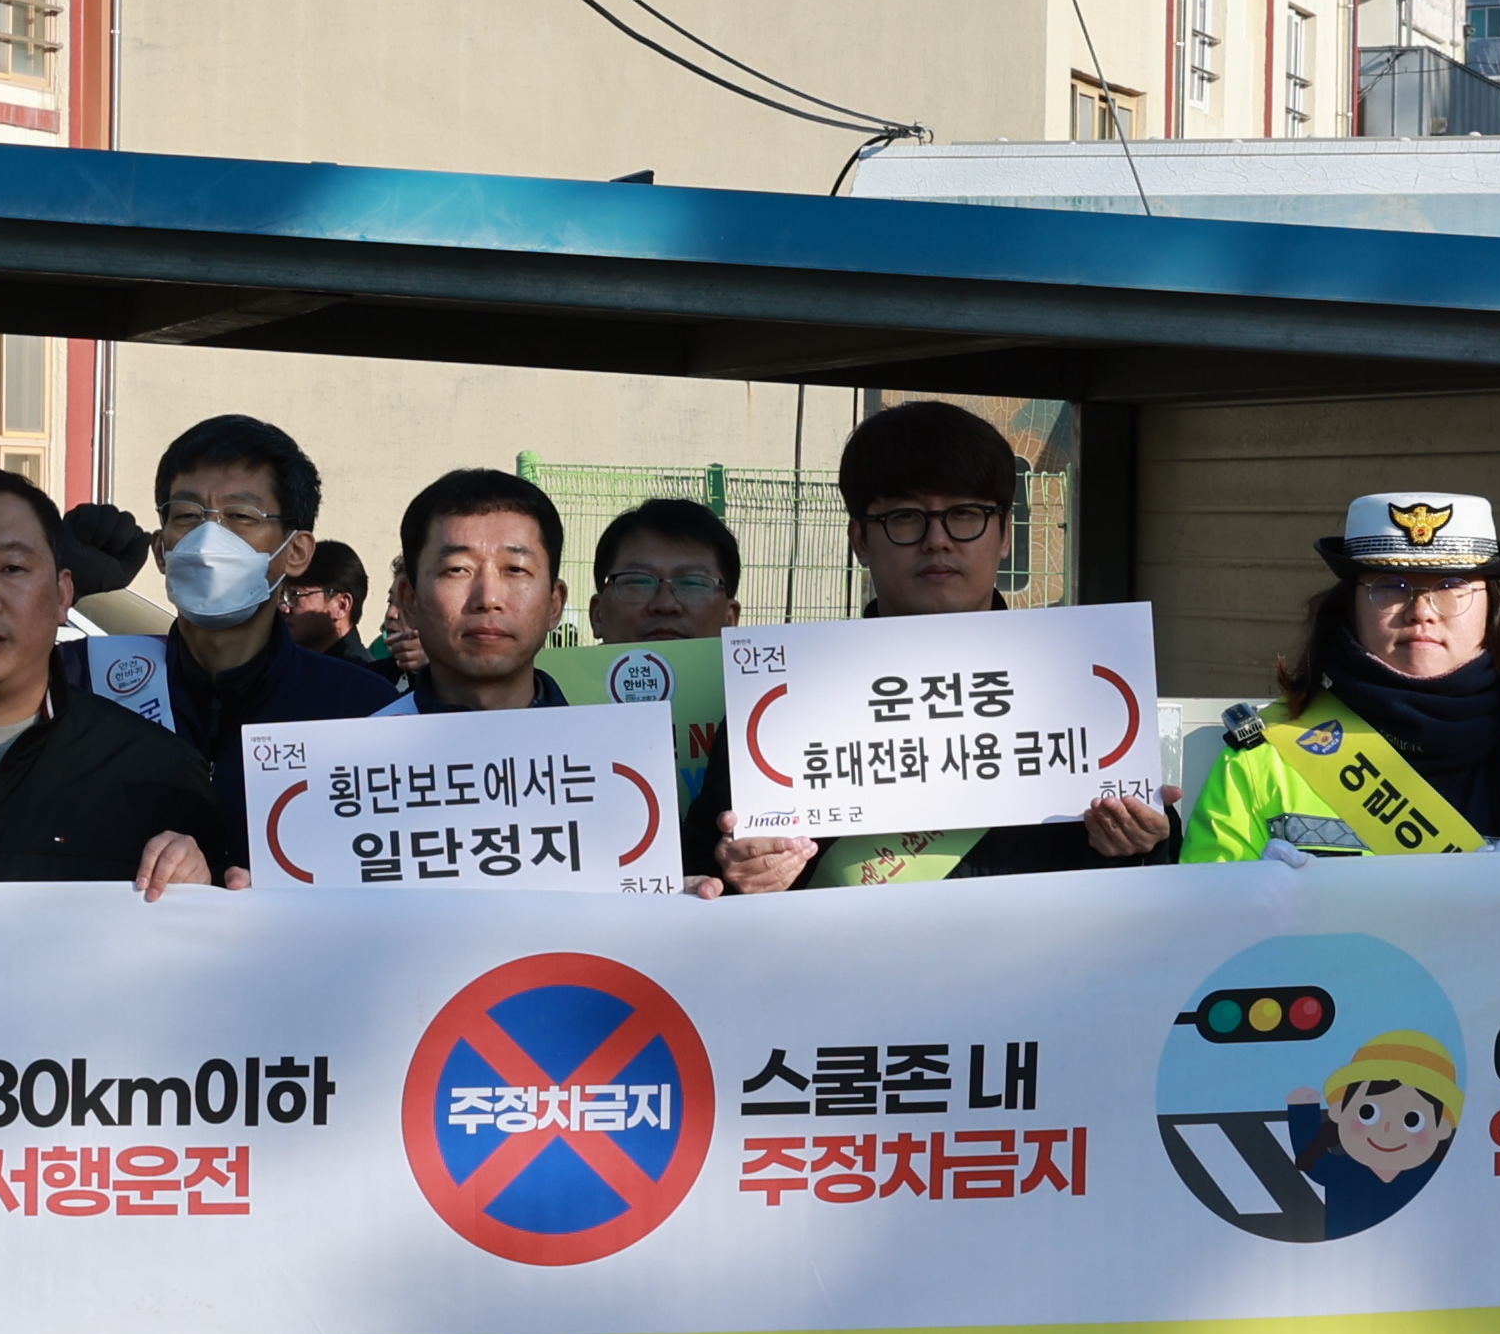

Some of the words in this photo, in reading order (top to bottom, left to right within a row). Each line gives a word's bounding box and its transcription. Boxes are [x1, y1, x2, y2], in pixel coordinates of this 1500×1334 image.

[623, 678, 658, 691] 한바퀴
[628, 666, 651, 678] 안전
[733, 645, 787, 675] 안전
[867, 669, 1015, 723] 운전중
[253, 742, 307, 771] 안전
[801, 733, 929, 790] 휴대전화
[939, 730, 1004, 782] 사용
[1012, 724, 1090, 778] 금지!
[326, 753, 598, 819] 횡단보도에서는
[1339, 751, 1440, 849] 어린이
[744, 810, 791, 828] Jindo
[806, 806, 864, 825] 진도군
[350, 820, 583, 882] 일단정지
[740, 1041, 953, 1117] 스쿨존
[968, 1040, 1039, 1112] 내
[446, 1081, 672, 1135] 주정차금지
[737, 1126, 1088, 1208] 주정차금지
